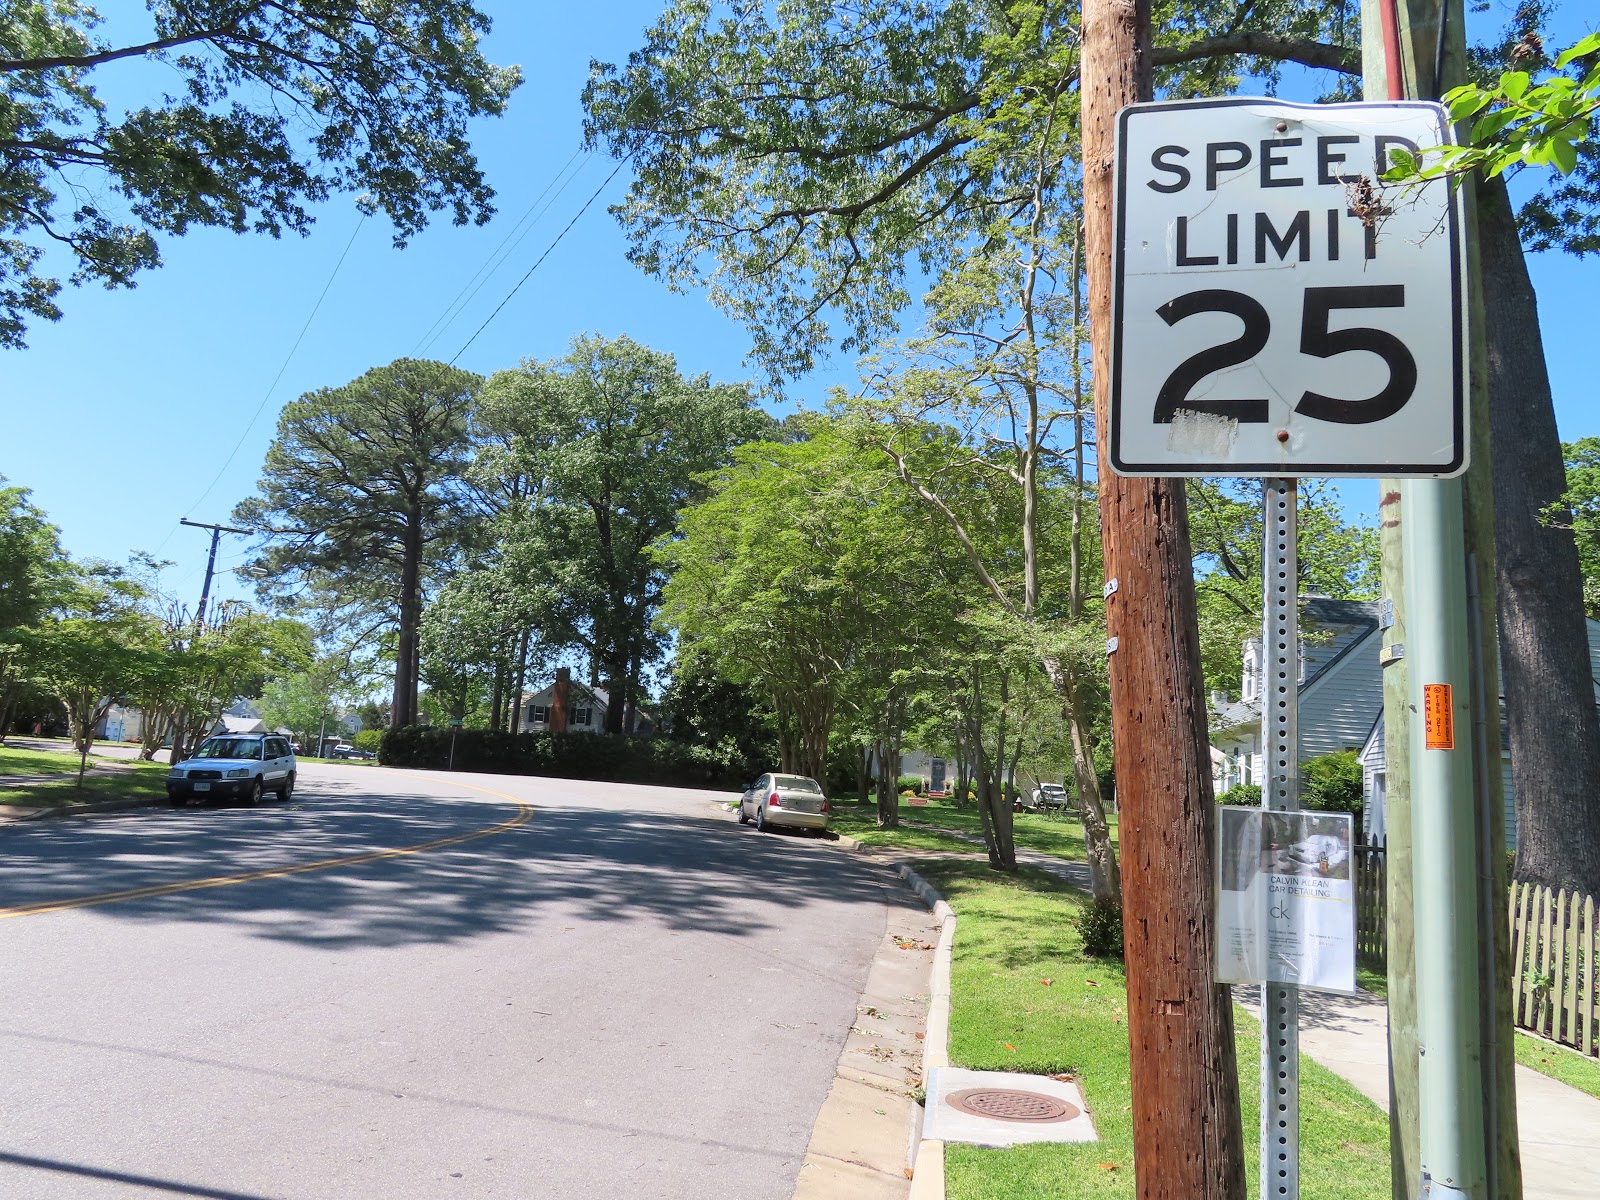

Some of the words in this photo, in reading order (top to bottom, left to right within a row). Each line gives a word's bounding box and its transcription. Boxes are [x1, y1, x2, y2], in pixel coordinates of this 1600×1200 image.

[1147, 135, 1423, 194] SPEED
[1176, 209, 1392, 267] LIMIT
[1153, 284, 1418, 425] 25
[1268, 885, 1286, 894] CAR
[1287, 886, 1331, 898] DETAILING
[1270, 876, 1298, 885] CALVIN
[1301, 879, 1330, 888] KLEAN
